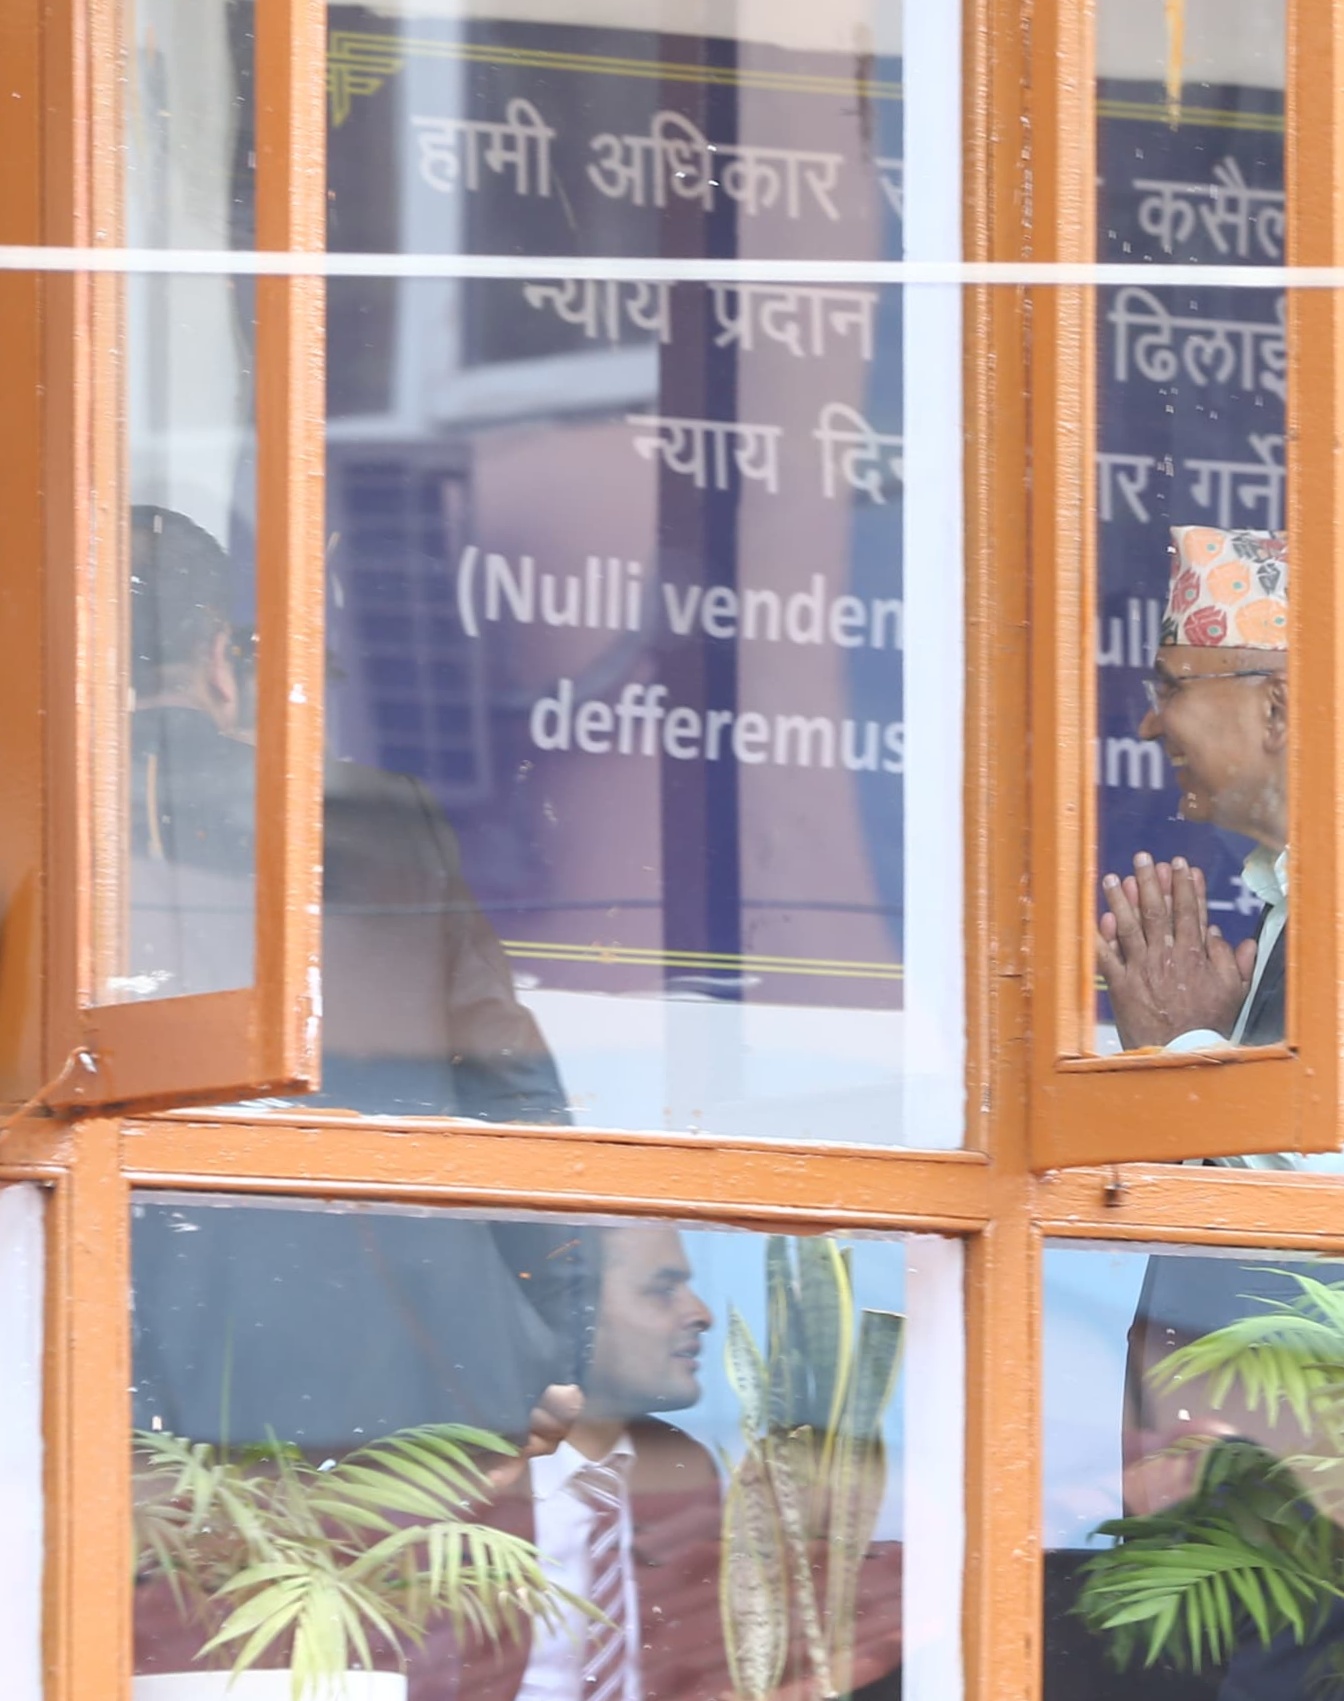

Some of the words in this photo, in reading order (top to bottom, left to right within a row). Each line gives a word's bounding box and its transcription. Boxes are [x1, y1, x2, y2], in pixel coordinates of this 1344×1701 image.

[411, 98, 558, 197] हामी
[586, 110, 844, 221] अधिकार
[708, 280, 880, 361] प्रदान
[626, 414, 783, 494] न्याय
[456, 546, 643, 637] (Nulli
[530, 678, 904, 774] defferemus
